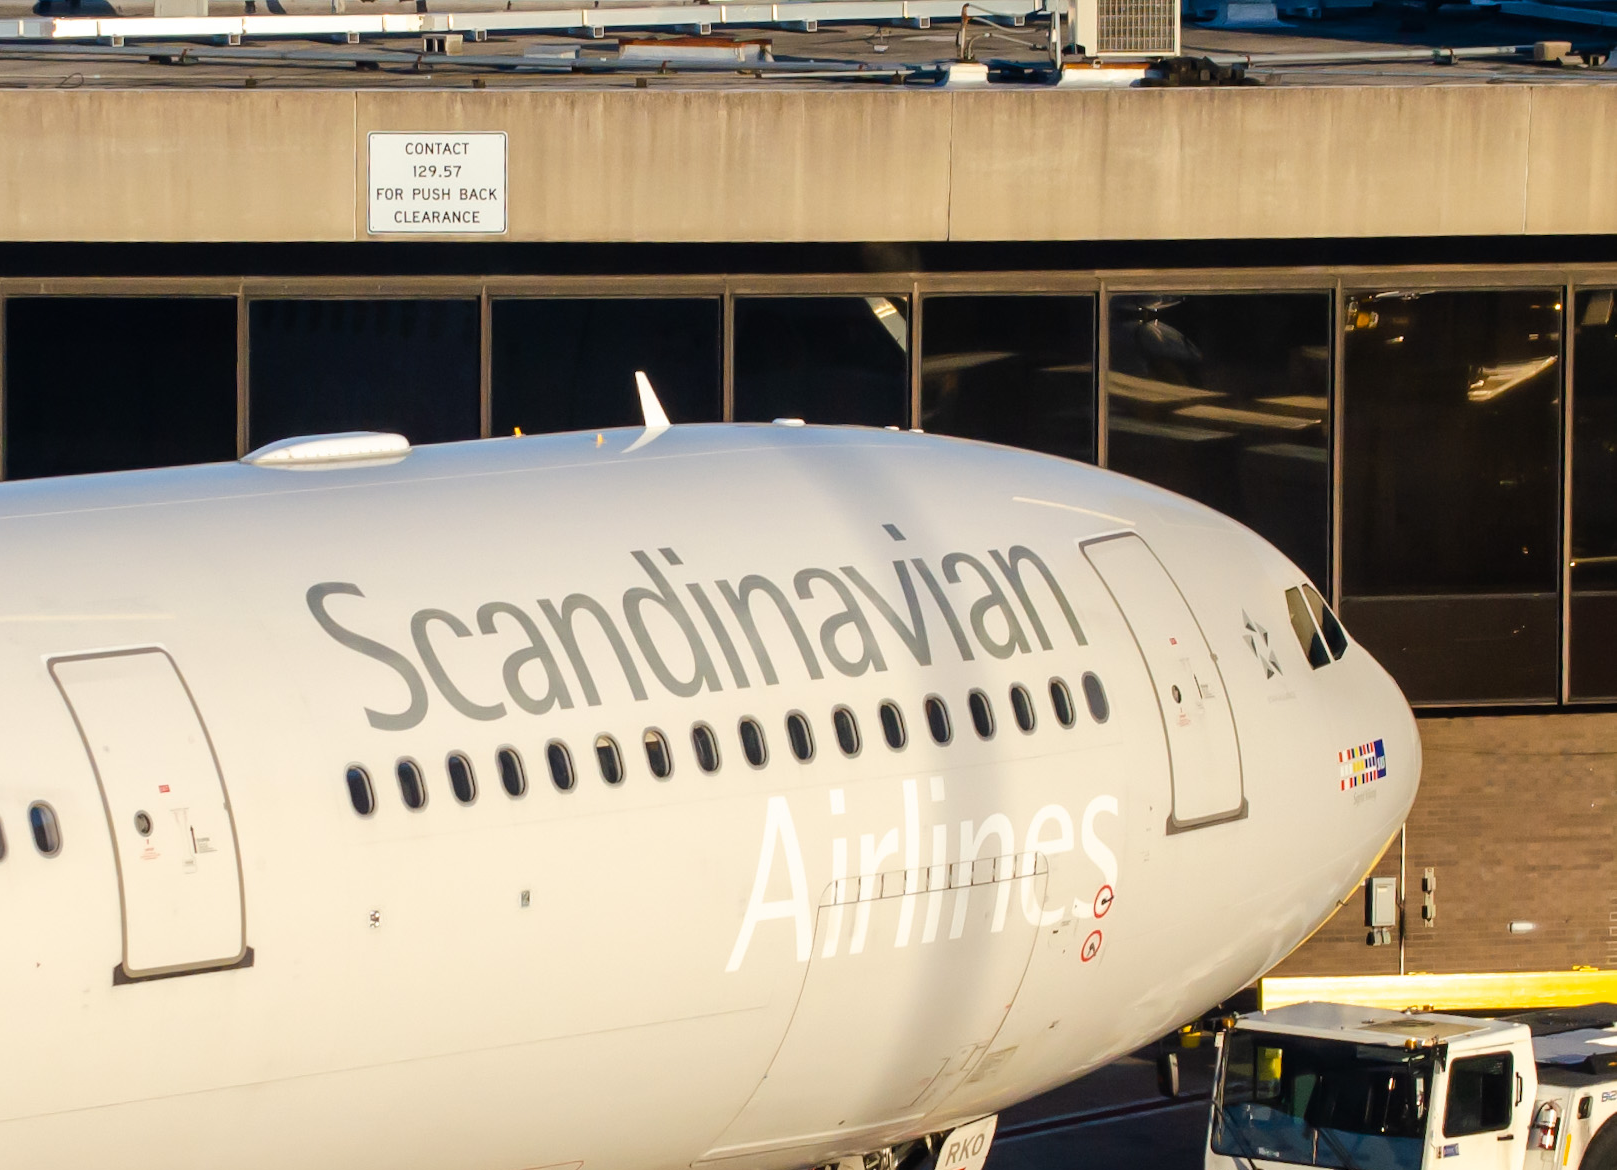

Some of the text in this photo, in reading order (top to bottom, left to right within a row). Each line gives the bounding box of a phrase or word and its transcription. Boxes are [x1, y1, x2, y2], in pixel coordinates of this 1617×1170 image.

[405, 142, 467, 155] CONTACT
[413, 165, 462, 178] 129.57
[376, 188, 497, 200] FOR PUSH BACK
[394, 211, 480, 223] CLEARANCE
[306, 523, 1089, 732] Scandinavian
[725, 777, 1120, 972] Airlines
[945, 1133, 985, 1167] RKO
